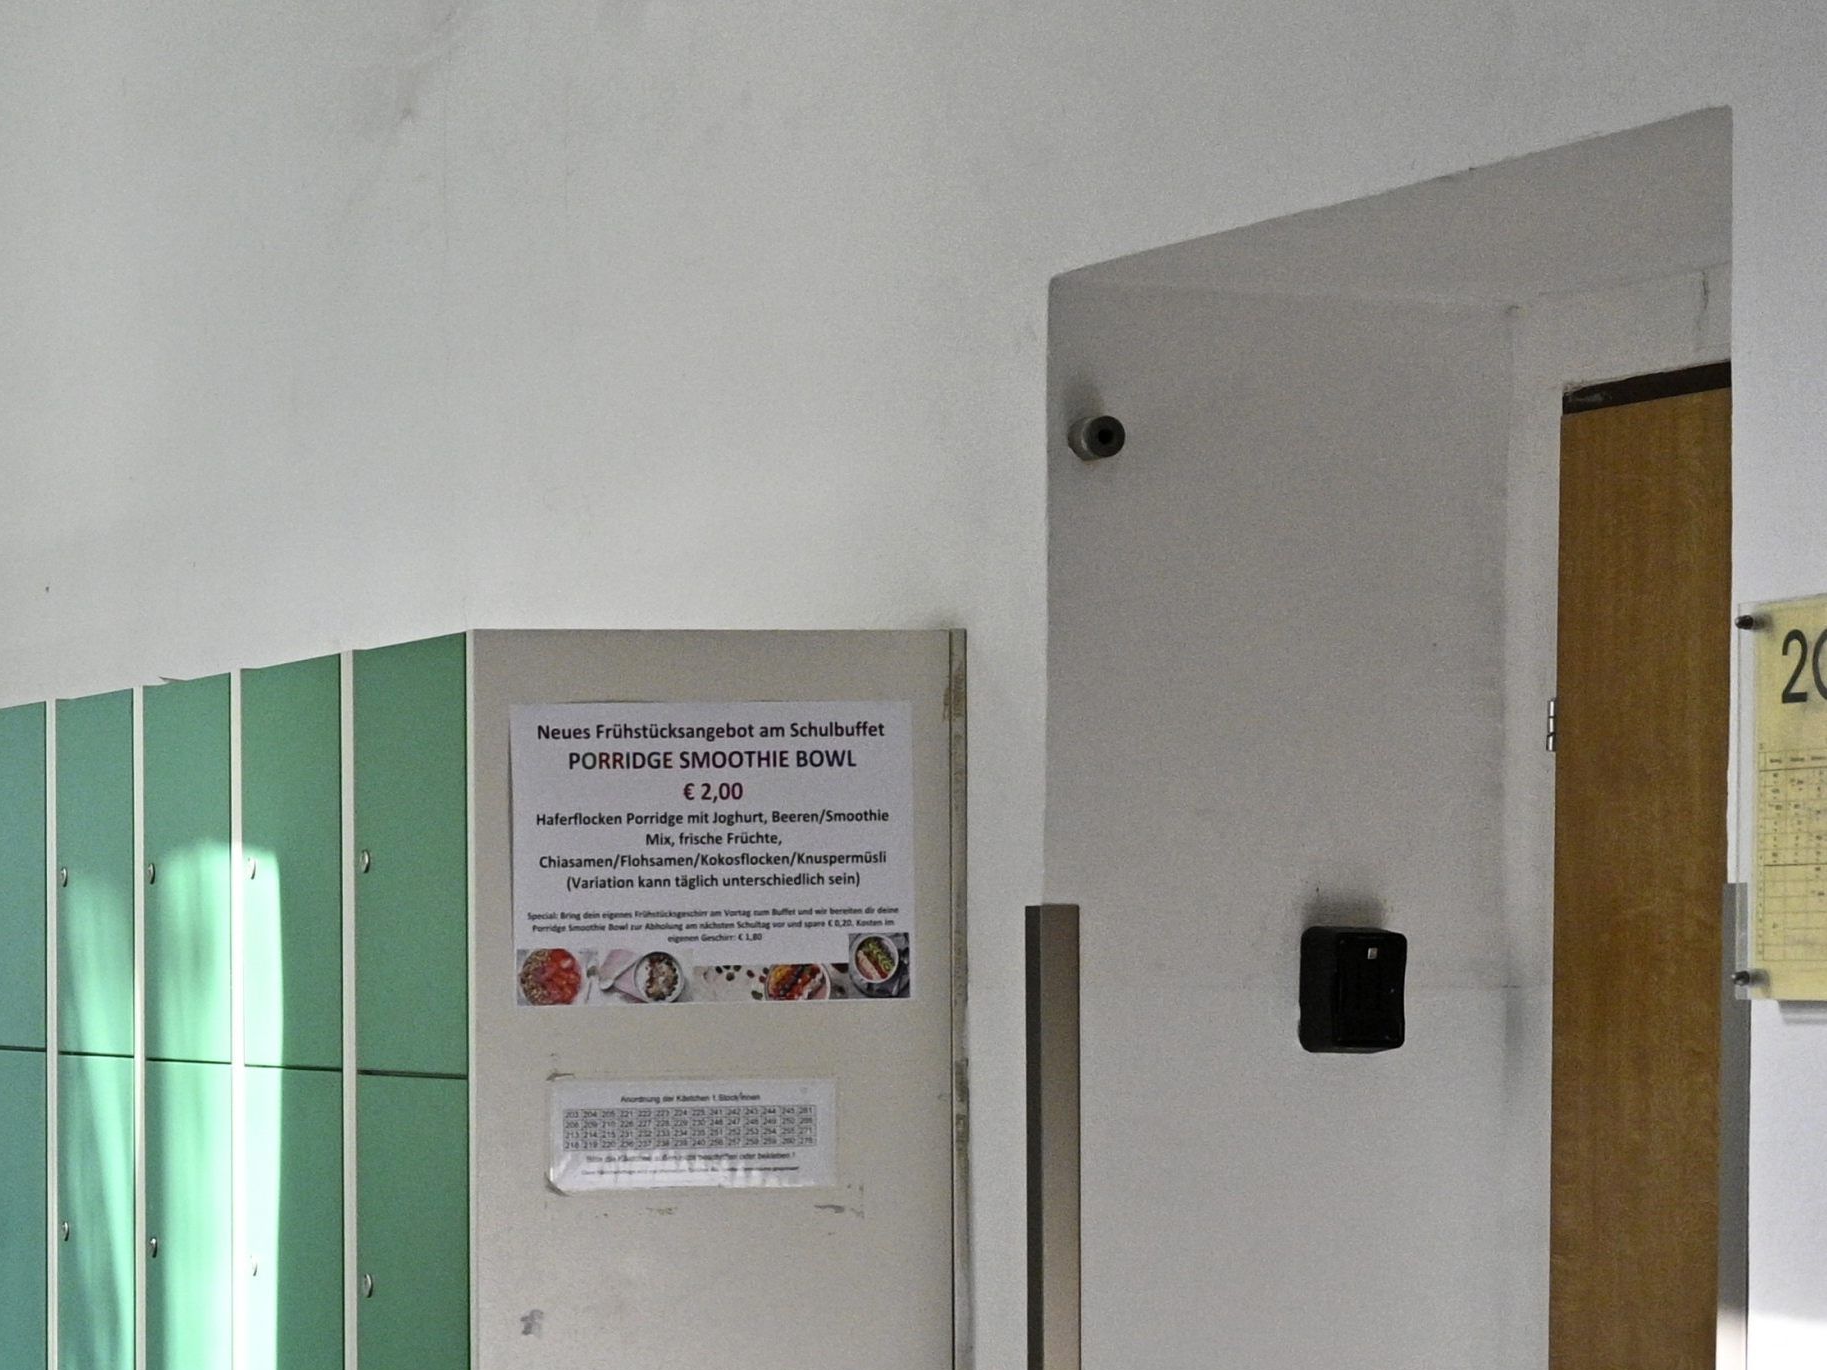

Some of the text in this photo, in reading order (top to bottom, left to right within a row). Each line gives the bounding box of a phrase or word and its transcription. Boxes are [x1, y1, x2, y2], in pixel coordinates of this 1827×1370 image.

[537, 721, 885, 742] Neues Frühstücksangebot am Schulbuffet
[569, 749, 857, 770] PORRIDGE SMOOTHIE BOWL
[683, 782, 743, 803] € 2,00
[536, 809, 889, 827] Haferflocken Porridge mit Joghurt, Beeren/Smoothie
[645, 832, 782, 847] Mix, frische Früchte,
[539, 851, 887, 870] Chiasamen/Flohsamen/Kokosflocken/Knuspermüsli
[567, 872, 860, 892] (Variation kann täglich unterschiedlich sein)
